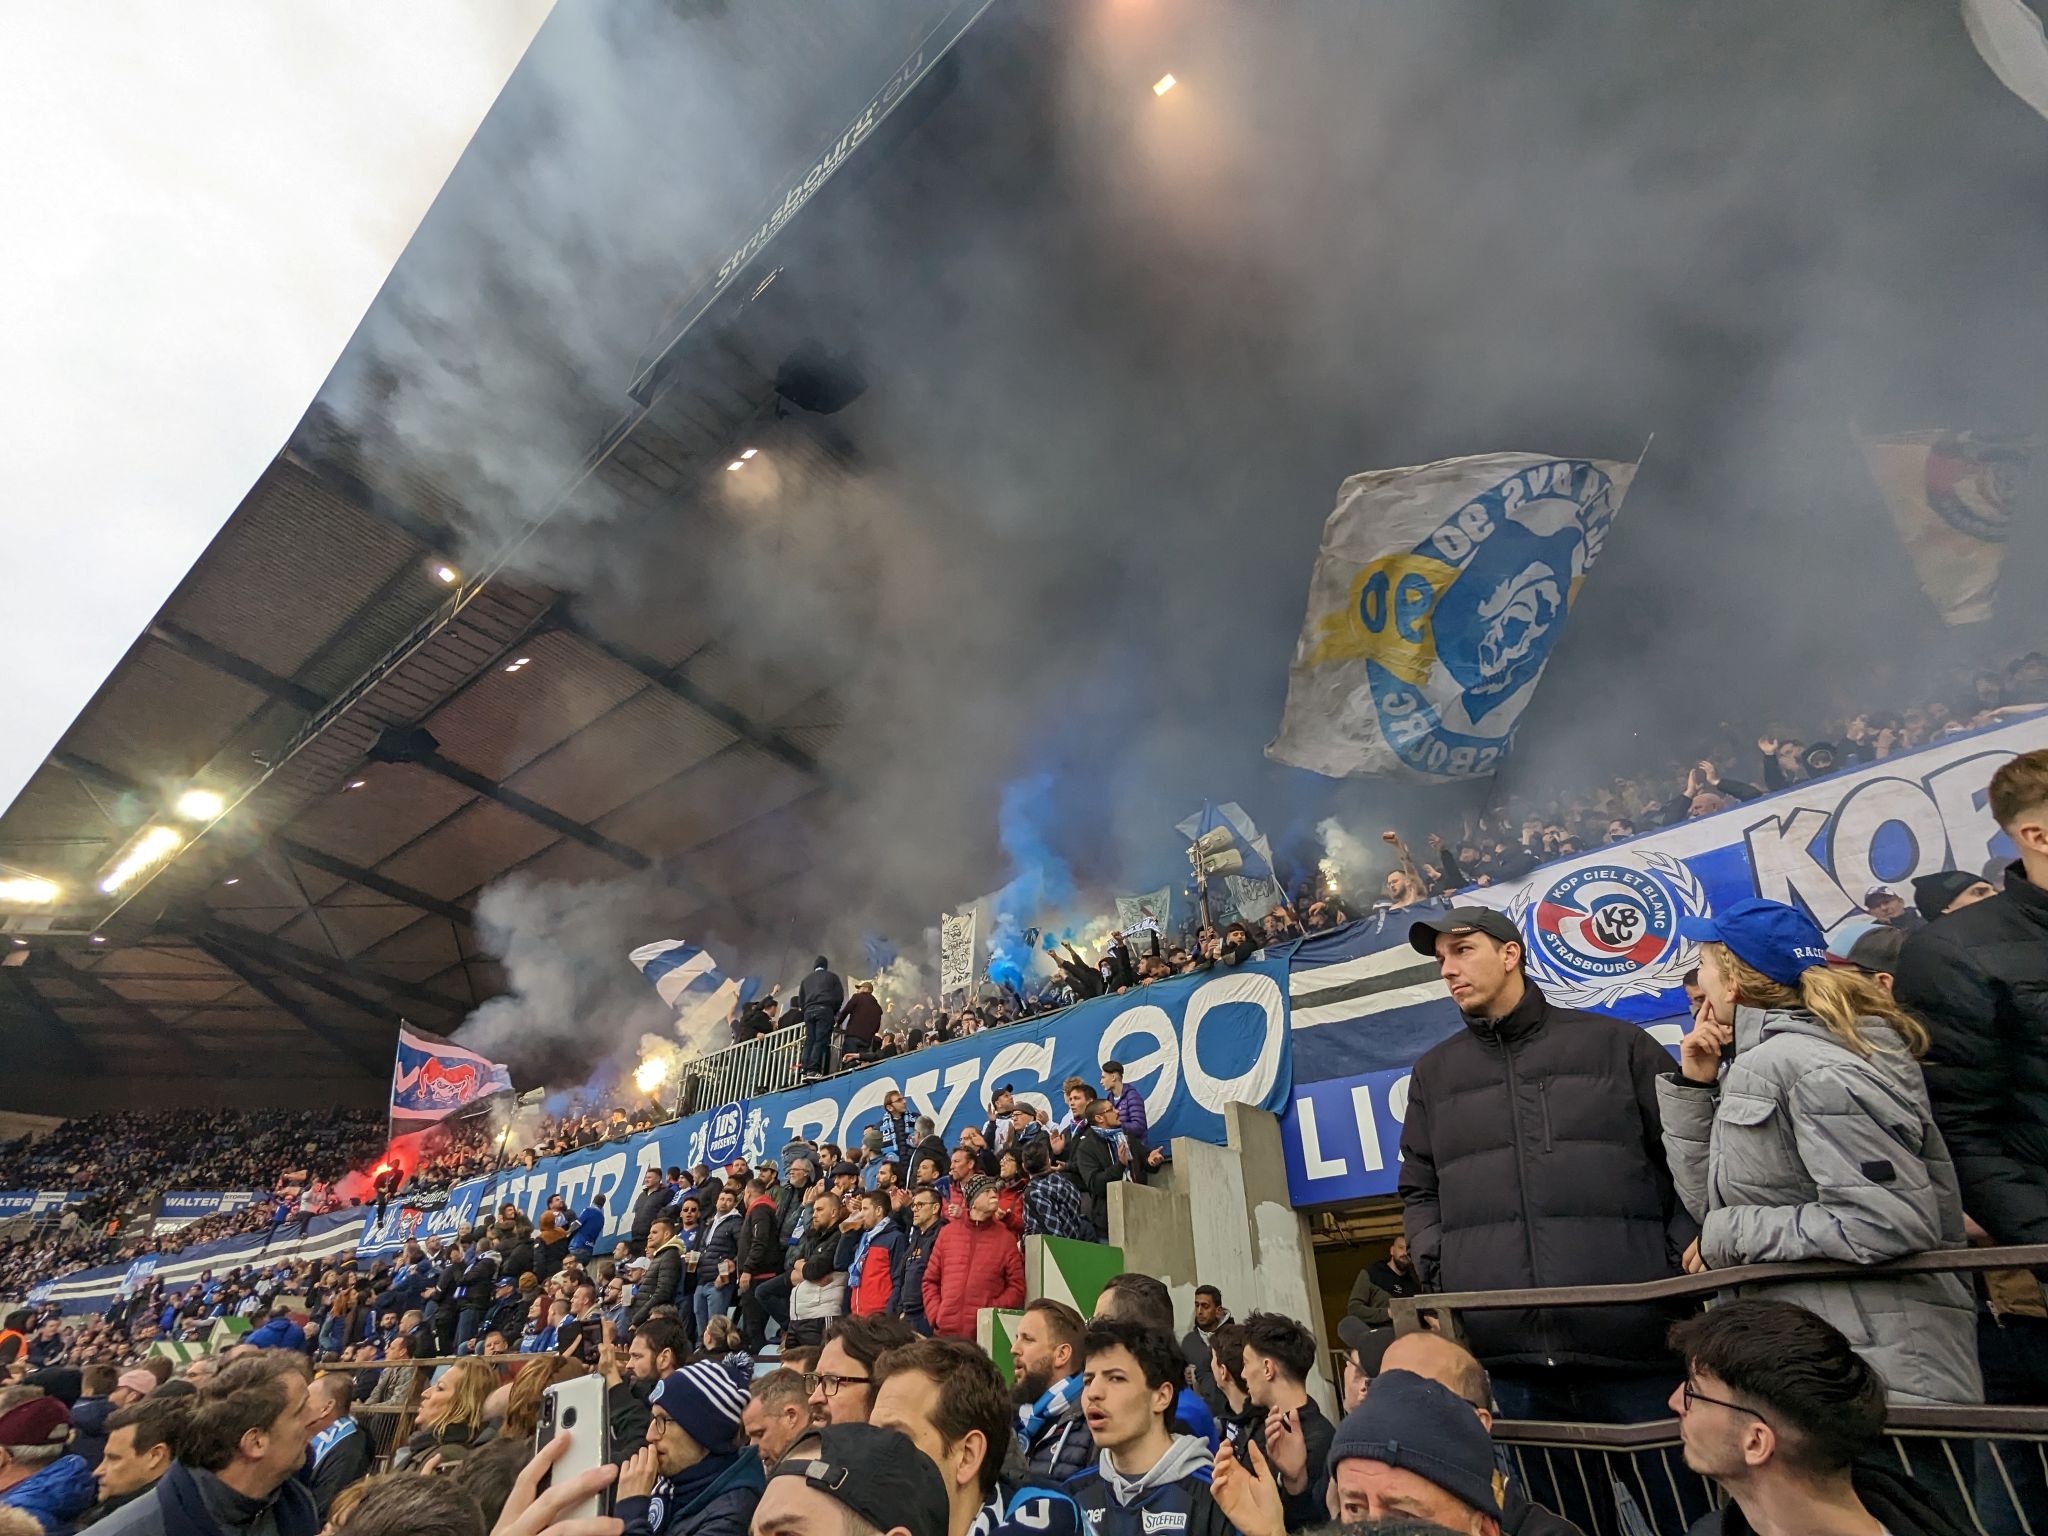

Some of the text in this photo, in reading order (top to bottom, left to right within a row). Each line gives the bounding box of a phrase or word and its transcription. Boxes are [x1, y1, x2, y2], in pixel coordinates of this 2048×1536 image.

[1552, 870, 1667, 930] KOP CIEL ET BLANC
[1546, 932, 1637, 973] STRASBOURG
[783, 1037, 1056, 1160] BOYS
[1098, 972, 1285, 1130] 90
[715, 1110, 738, 1139] IDS
[0, 1197, 34, 1207] LTER
[165, 1197, 220, 1207] WALTER
